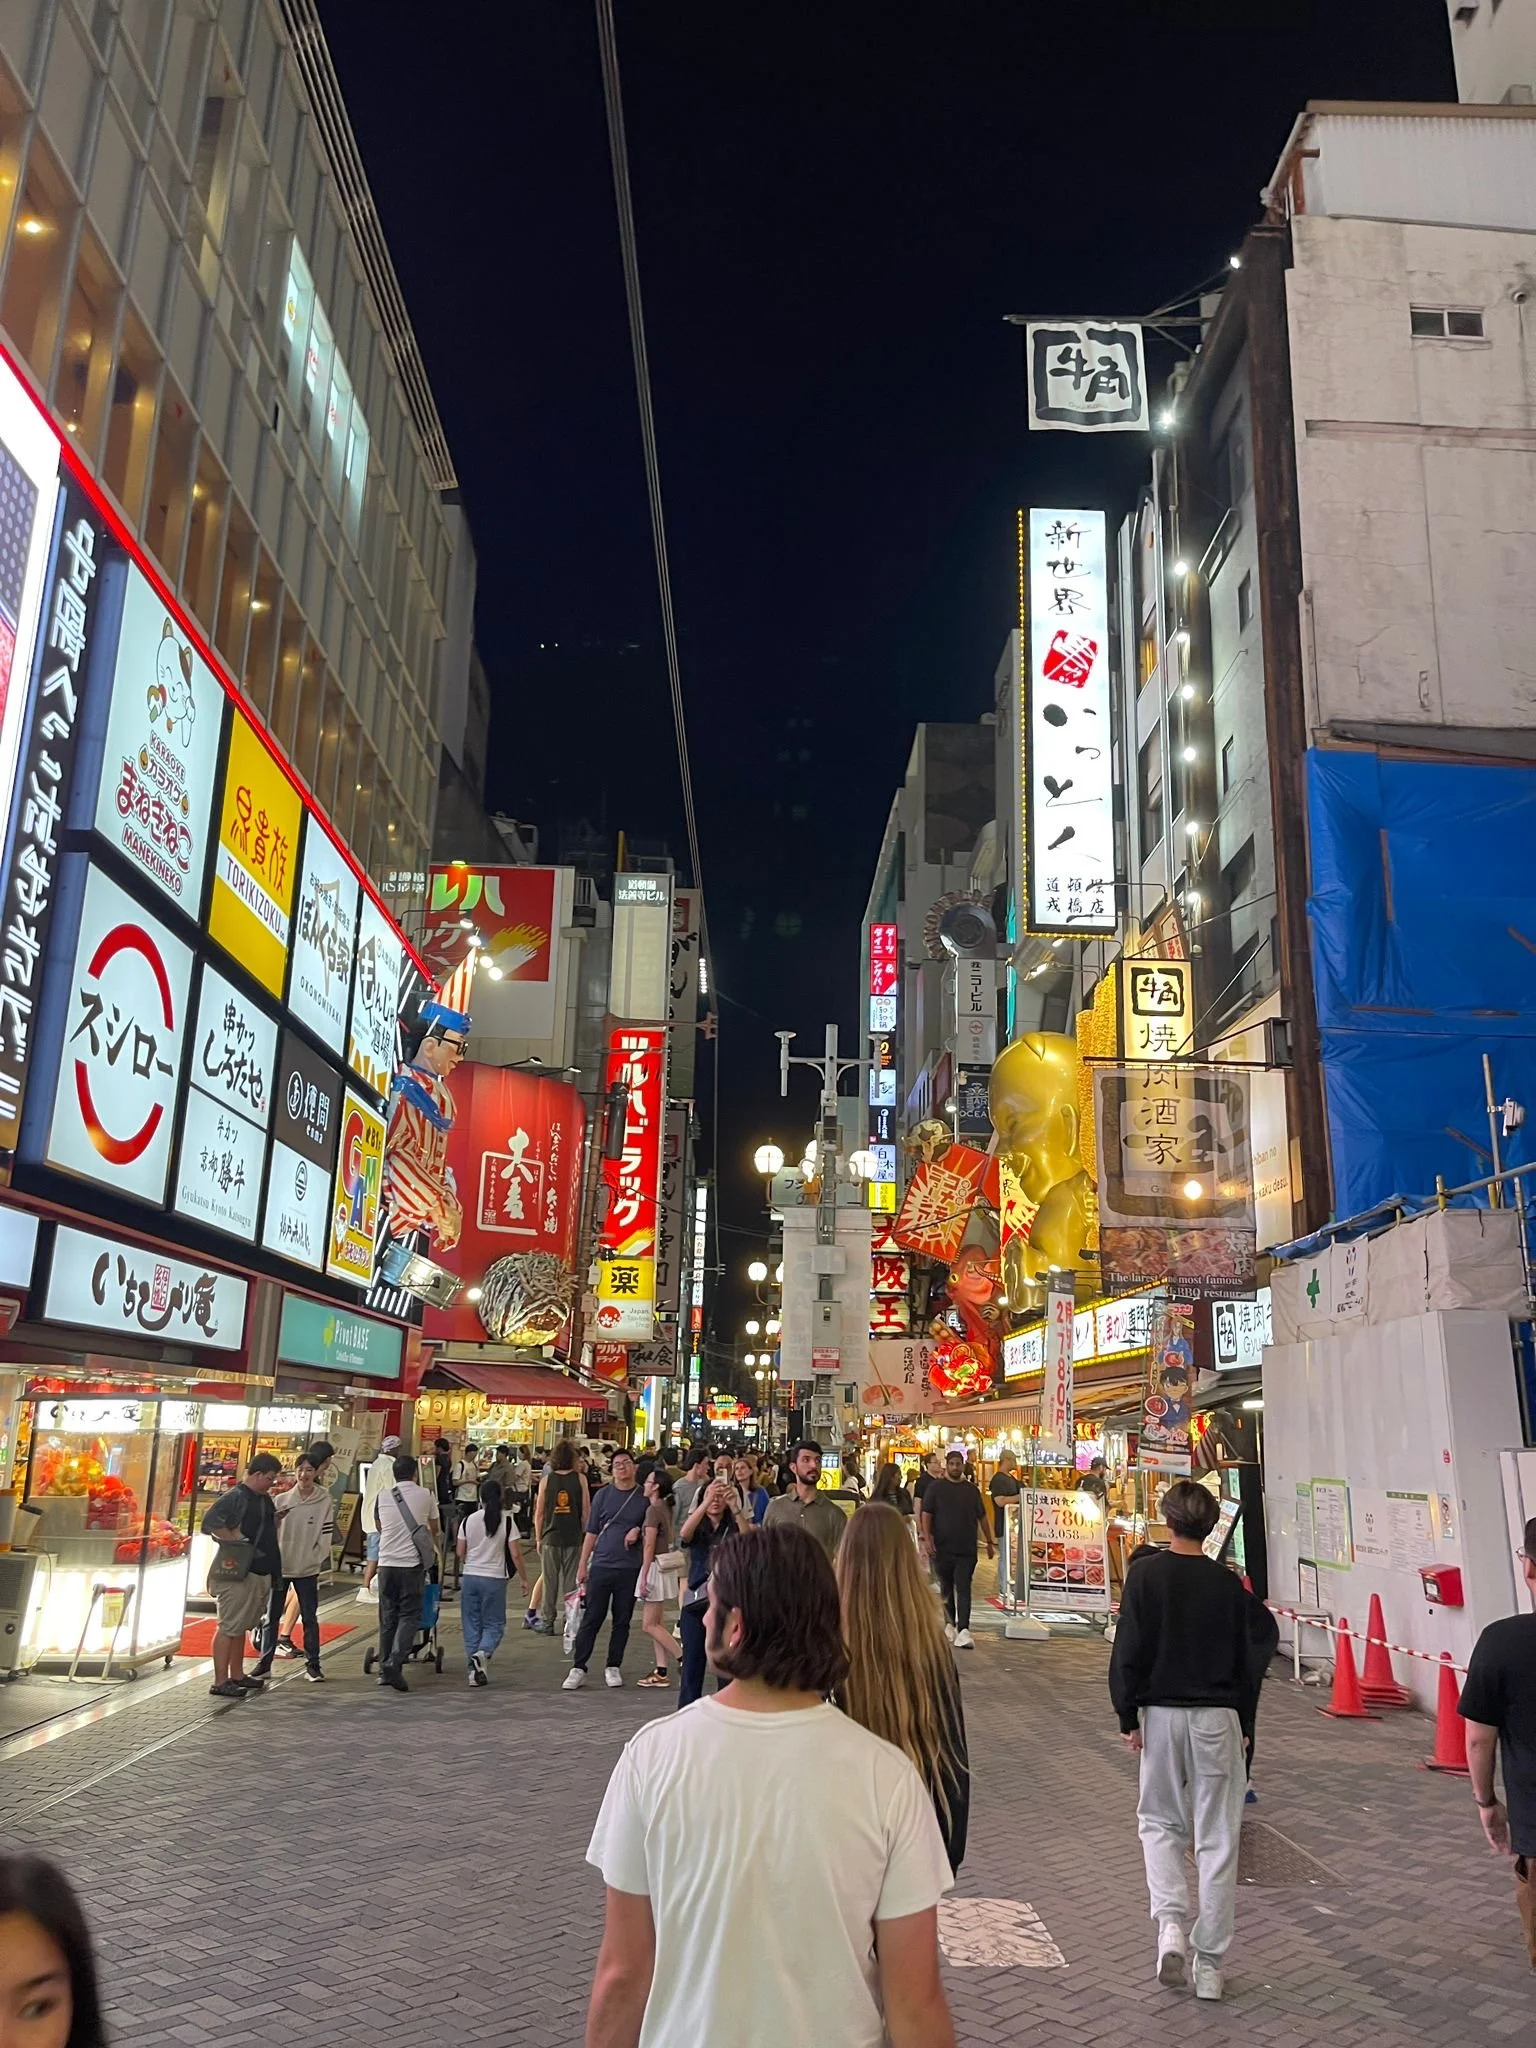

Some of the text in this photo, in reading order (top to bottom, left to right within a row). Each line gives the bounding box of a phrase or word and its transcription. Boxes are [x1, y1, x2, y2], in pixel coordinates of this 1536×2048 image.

[1048, 346, 1131, 402] 牛角
[1045, 520, 1091, 616] 新世界
[150, 730, 185, 781] KARAOKE
[150, 755, 182, 806] カラオケ
[116, 755, 193, 874] まねきねこ
[229, 785, 288, 898] 鳥貴族
[122, 823, 183, 897] MANEKINEKO
[227, 856, 282, 936] TORIKIZOKU
[300, 894, 349, 986] ぼんくら家
[885, 927, 895, 975] ダーツ &
[299, 974, 343, 1026] OKONOMIYAKI
[1139, 976, 1179, 1007] 牛角
[69, 986, 174, 1080] スシロー
[202, 1028, 264, 1108] しろたや
[1139, 1022, 1183, 1166] 焼肉酒家
[959, 1110, 988, 1119] OCEA
[199, 1144, 246, 1202] 京都勝牛
[878, 1148, 894, 1180] 白木屋
[92, 1251, 219, 1338] いちびり庵
[611, 1266, 640, 1294] 薬
[869, 1216, 909, 1331] 大阪王
[1108, 1272, 1129, 1283] The
[1178, 1275, 1202, 1285] most
[1205, 1274, 1243, 1286] famous
[597, 1344, 627, 1355] ツルハ
[1220, 1316, 1236, 1350] 牛角
[1243, 1333, 1274, 1357] Gyu-K
